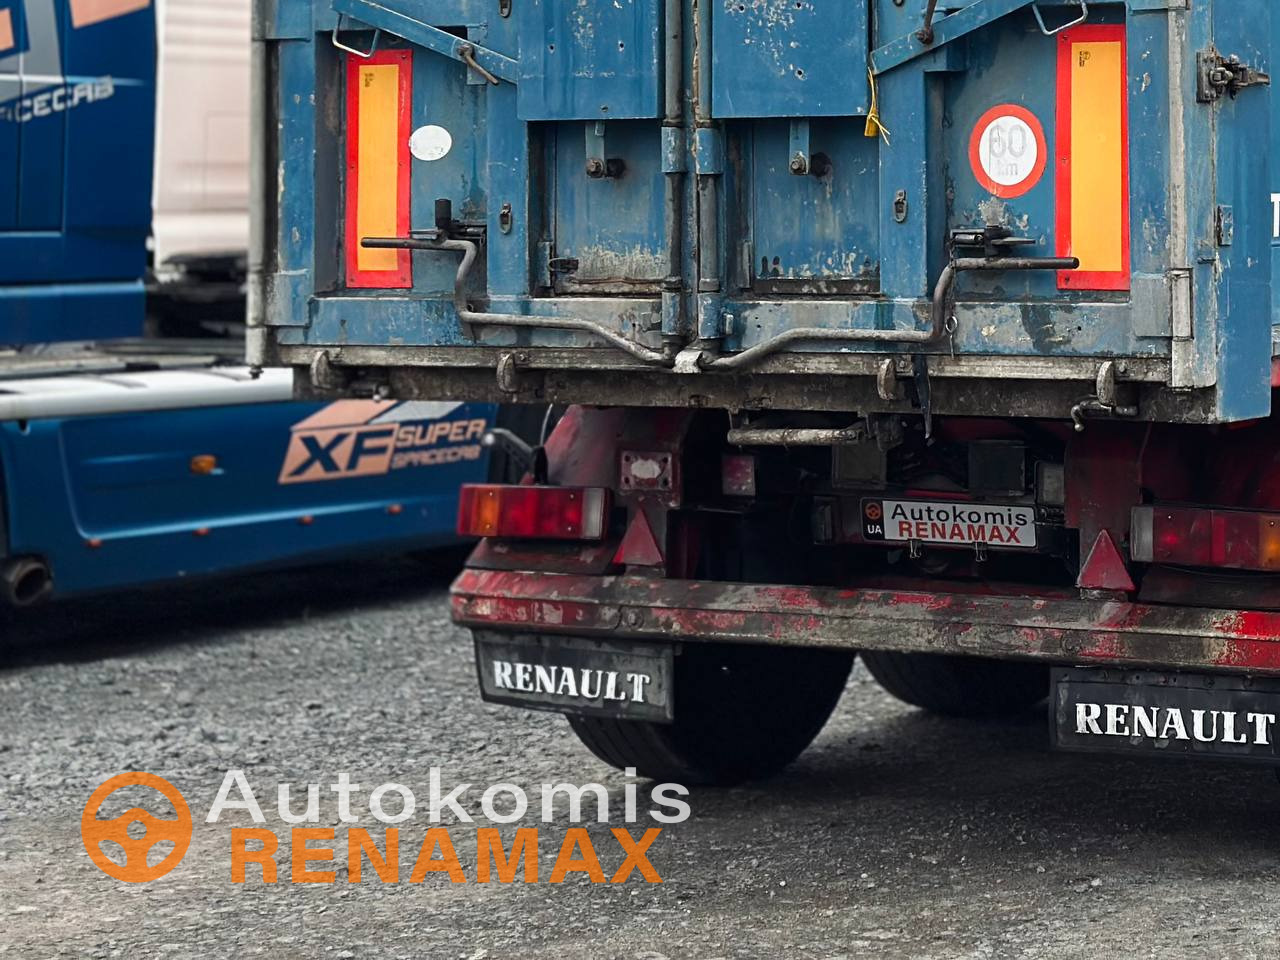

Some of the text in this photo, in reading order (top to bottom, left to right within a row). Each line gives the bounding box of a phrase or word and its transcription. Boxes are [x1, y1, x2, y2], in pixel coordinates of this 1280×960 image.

[989, 125, 1026, 158] 60
[286, 418, 487, 478] XF SUPER
[867, 524, 883, 535] UA
[891, 503, 1028, 527] Autokomis
[899, 521, 1021, 544] RENAMAX
[493, 660, 651, 703] RENAULT
[1075, 703, 1276, 745] RENAULT
